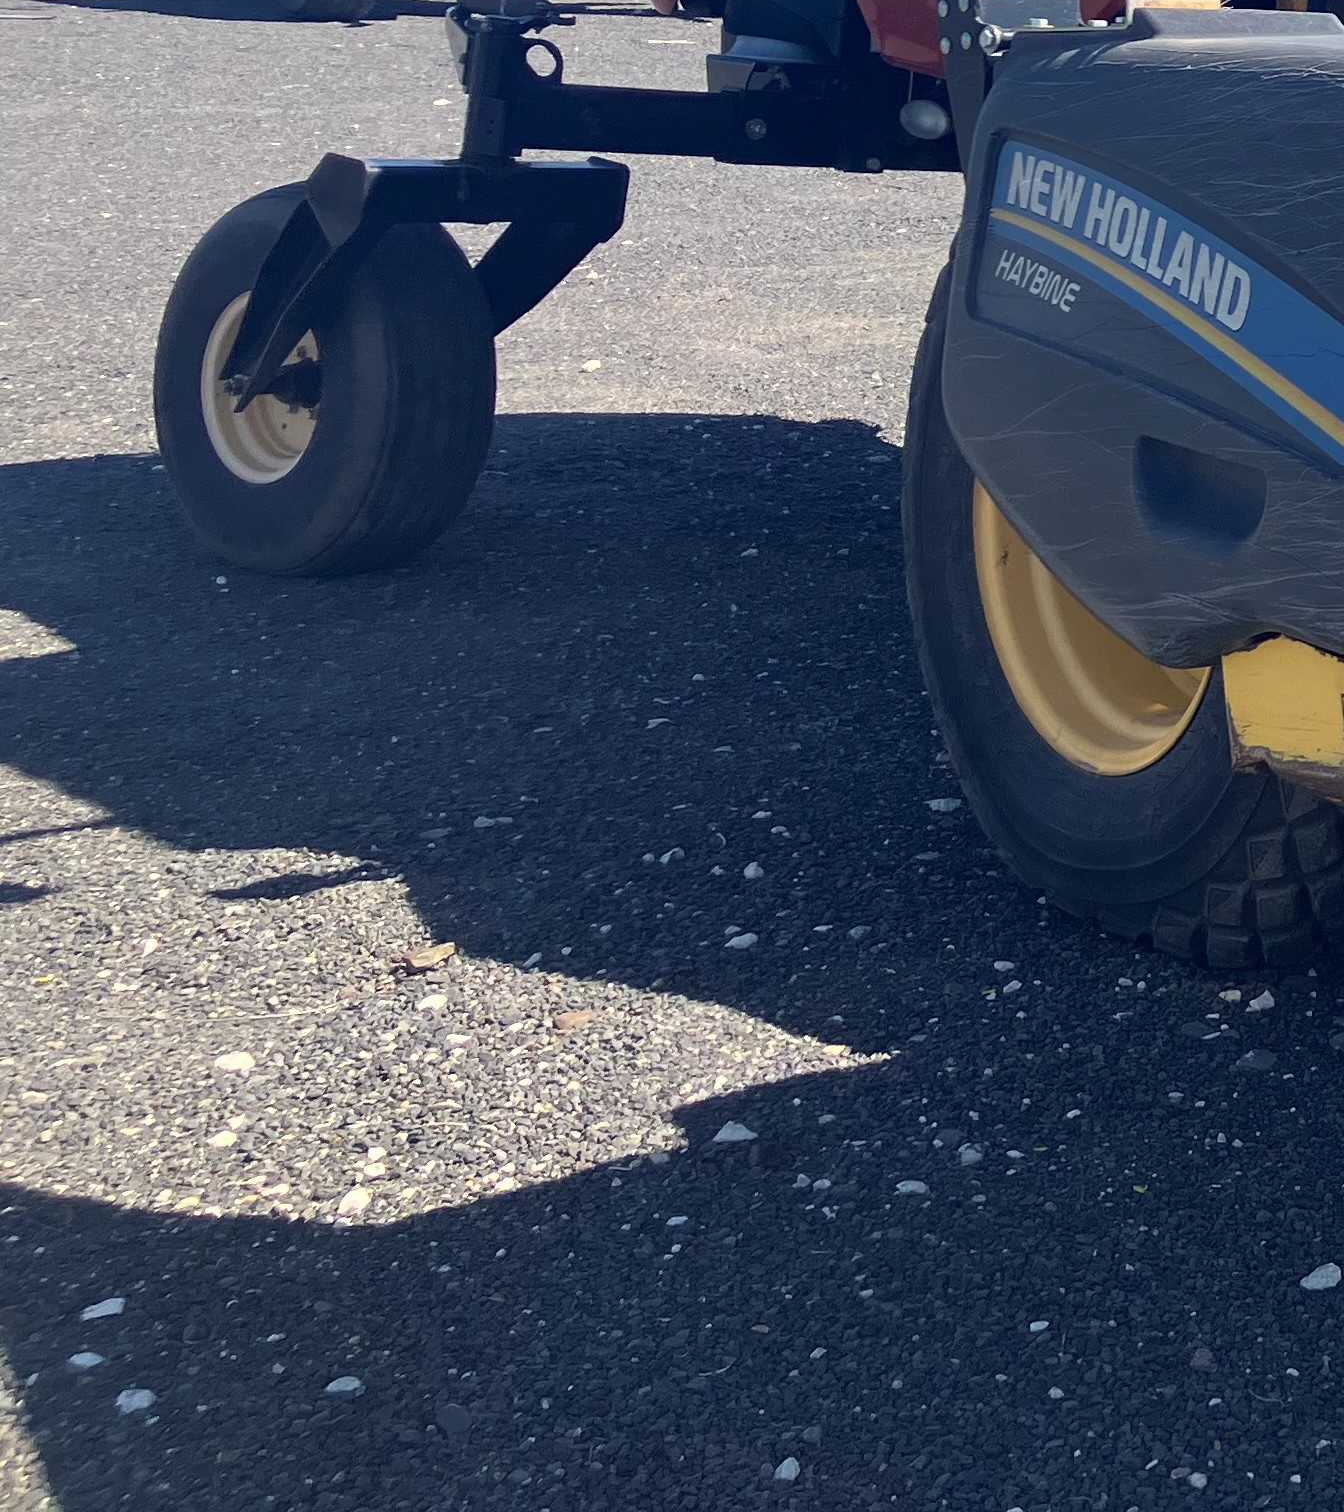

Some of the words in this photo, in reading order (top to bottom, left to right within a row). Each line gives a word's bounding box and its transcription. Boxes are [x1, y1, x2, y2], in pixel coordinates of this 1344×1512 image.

[995, 249, 1081, 313] HAYBINE
[1007, 151, 1086, 229] NEW
[1083, 182, 1251, 331] HOLLAND
